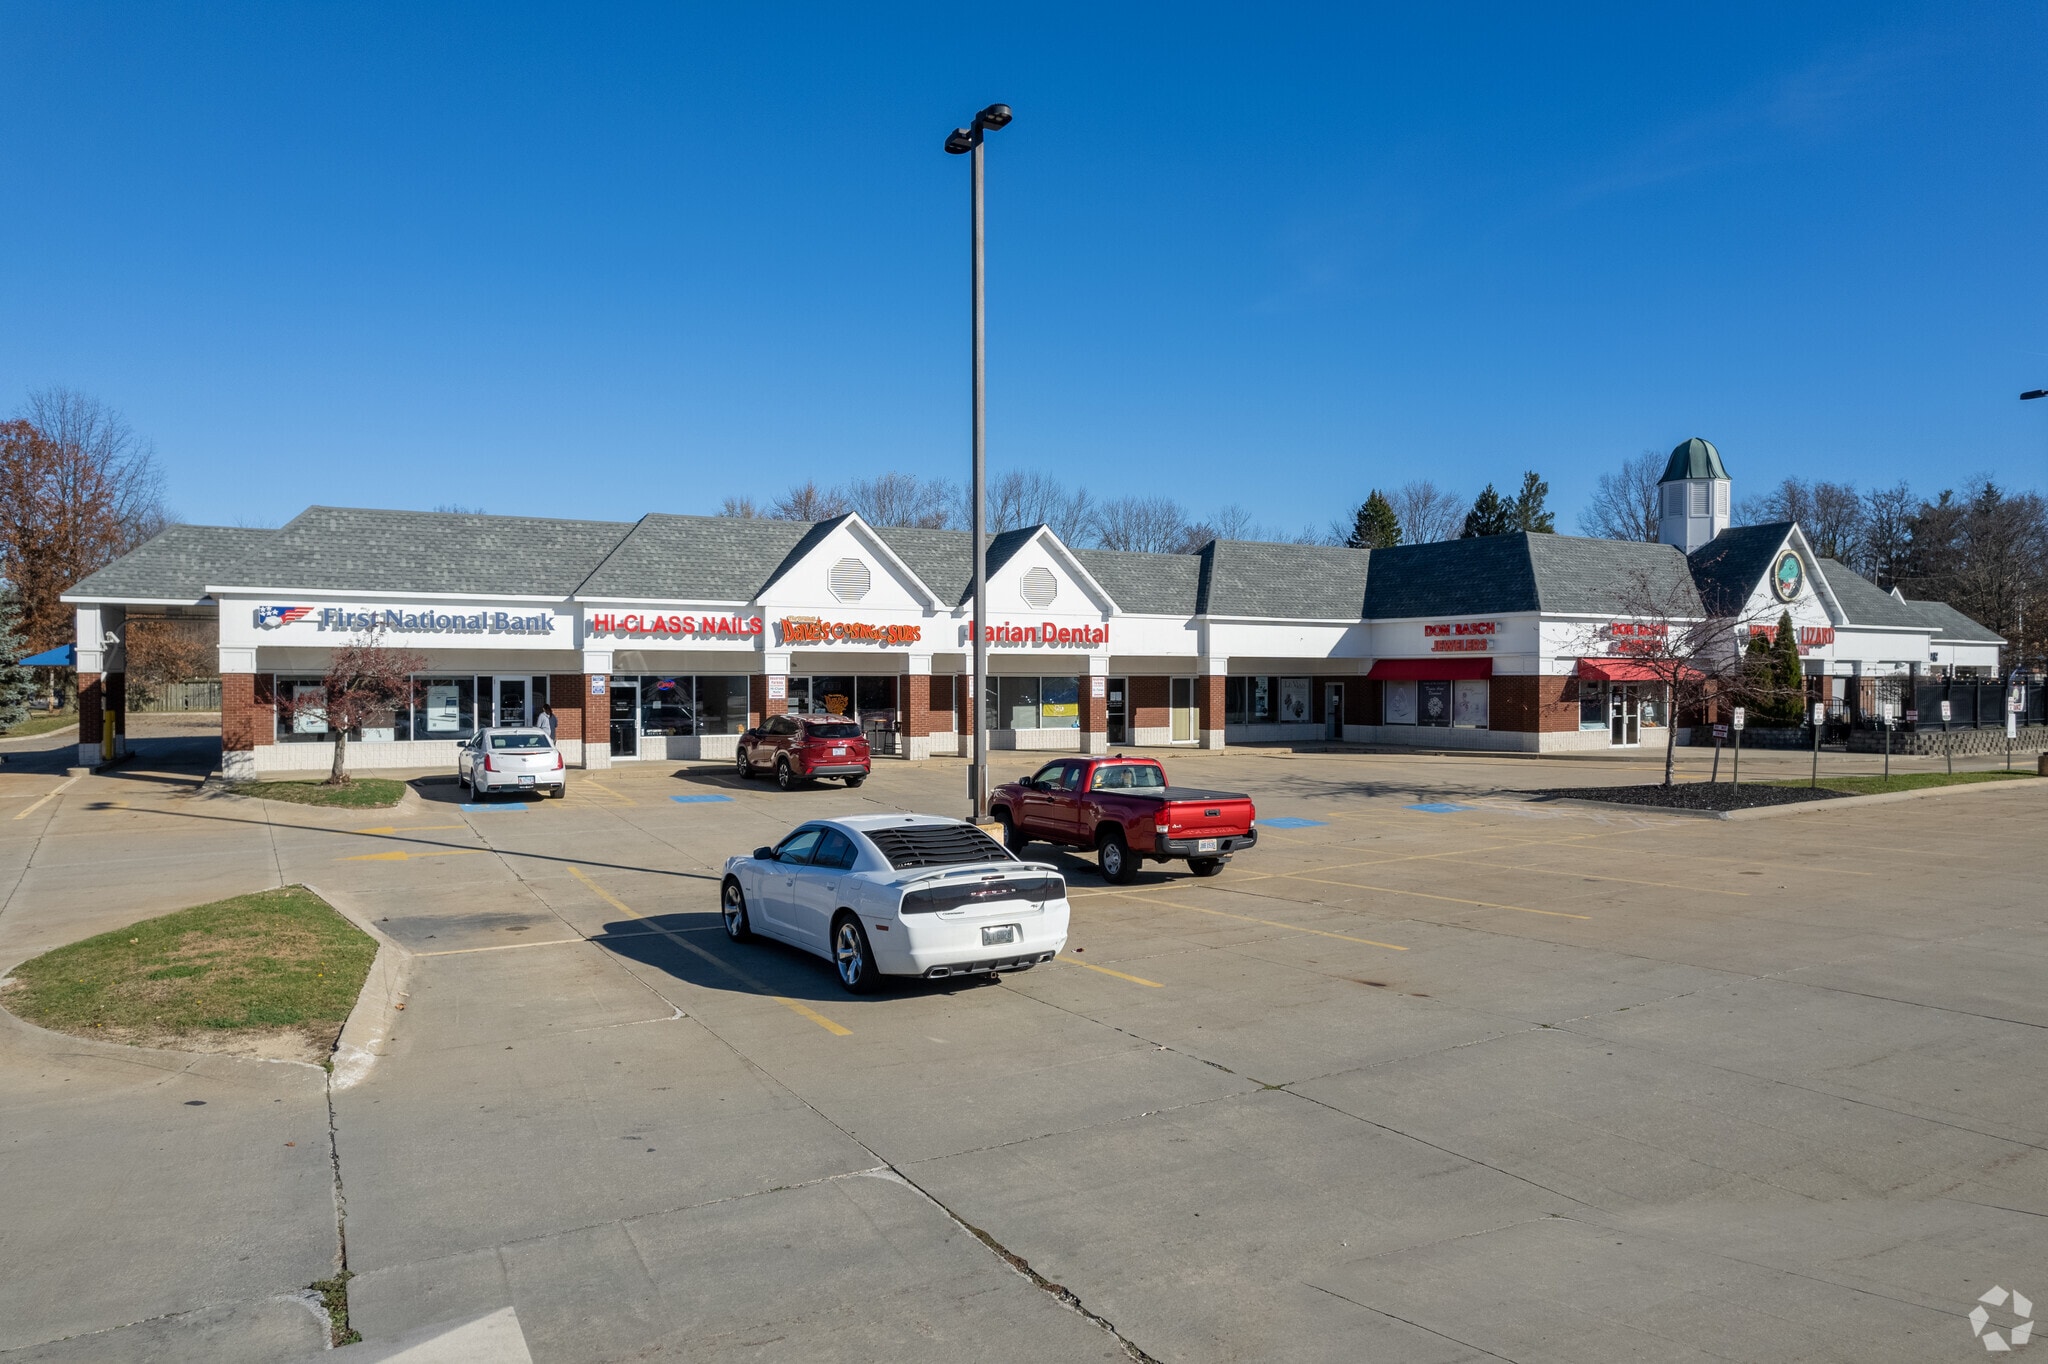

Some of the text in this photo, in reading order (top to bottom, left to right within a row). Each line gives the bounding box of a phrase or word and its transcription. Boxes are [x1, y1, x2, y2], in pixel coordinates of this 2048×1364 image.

[323, 607, 556, 631] First National Bank
[594, 613, 763, 635] HI-CLASS NAILS
[1424, 621, 1496, 637] DON BASCH
[1041, 621, 1110, 643] Dental
[1801, 625, 1835, 645] LIZARD
[1431, 638, 1488, 652] JEWELERS
